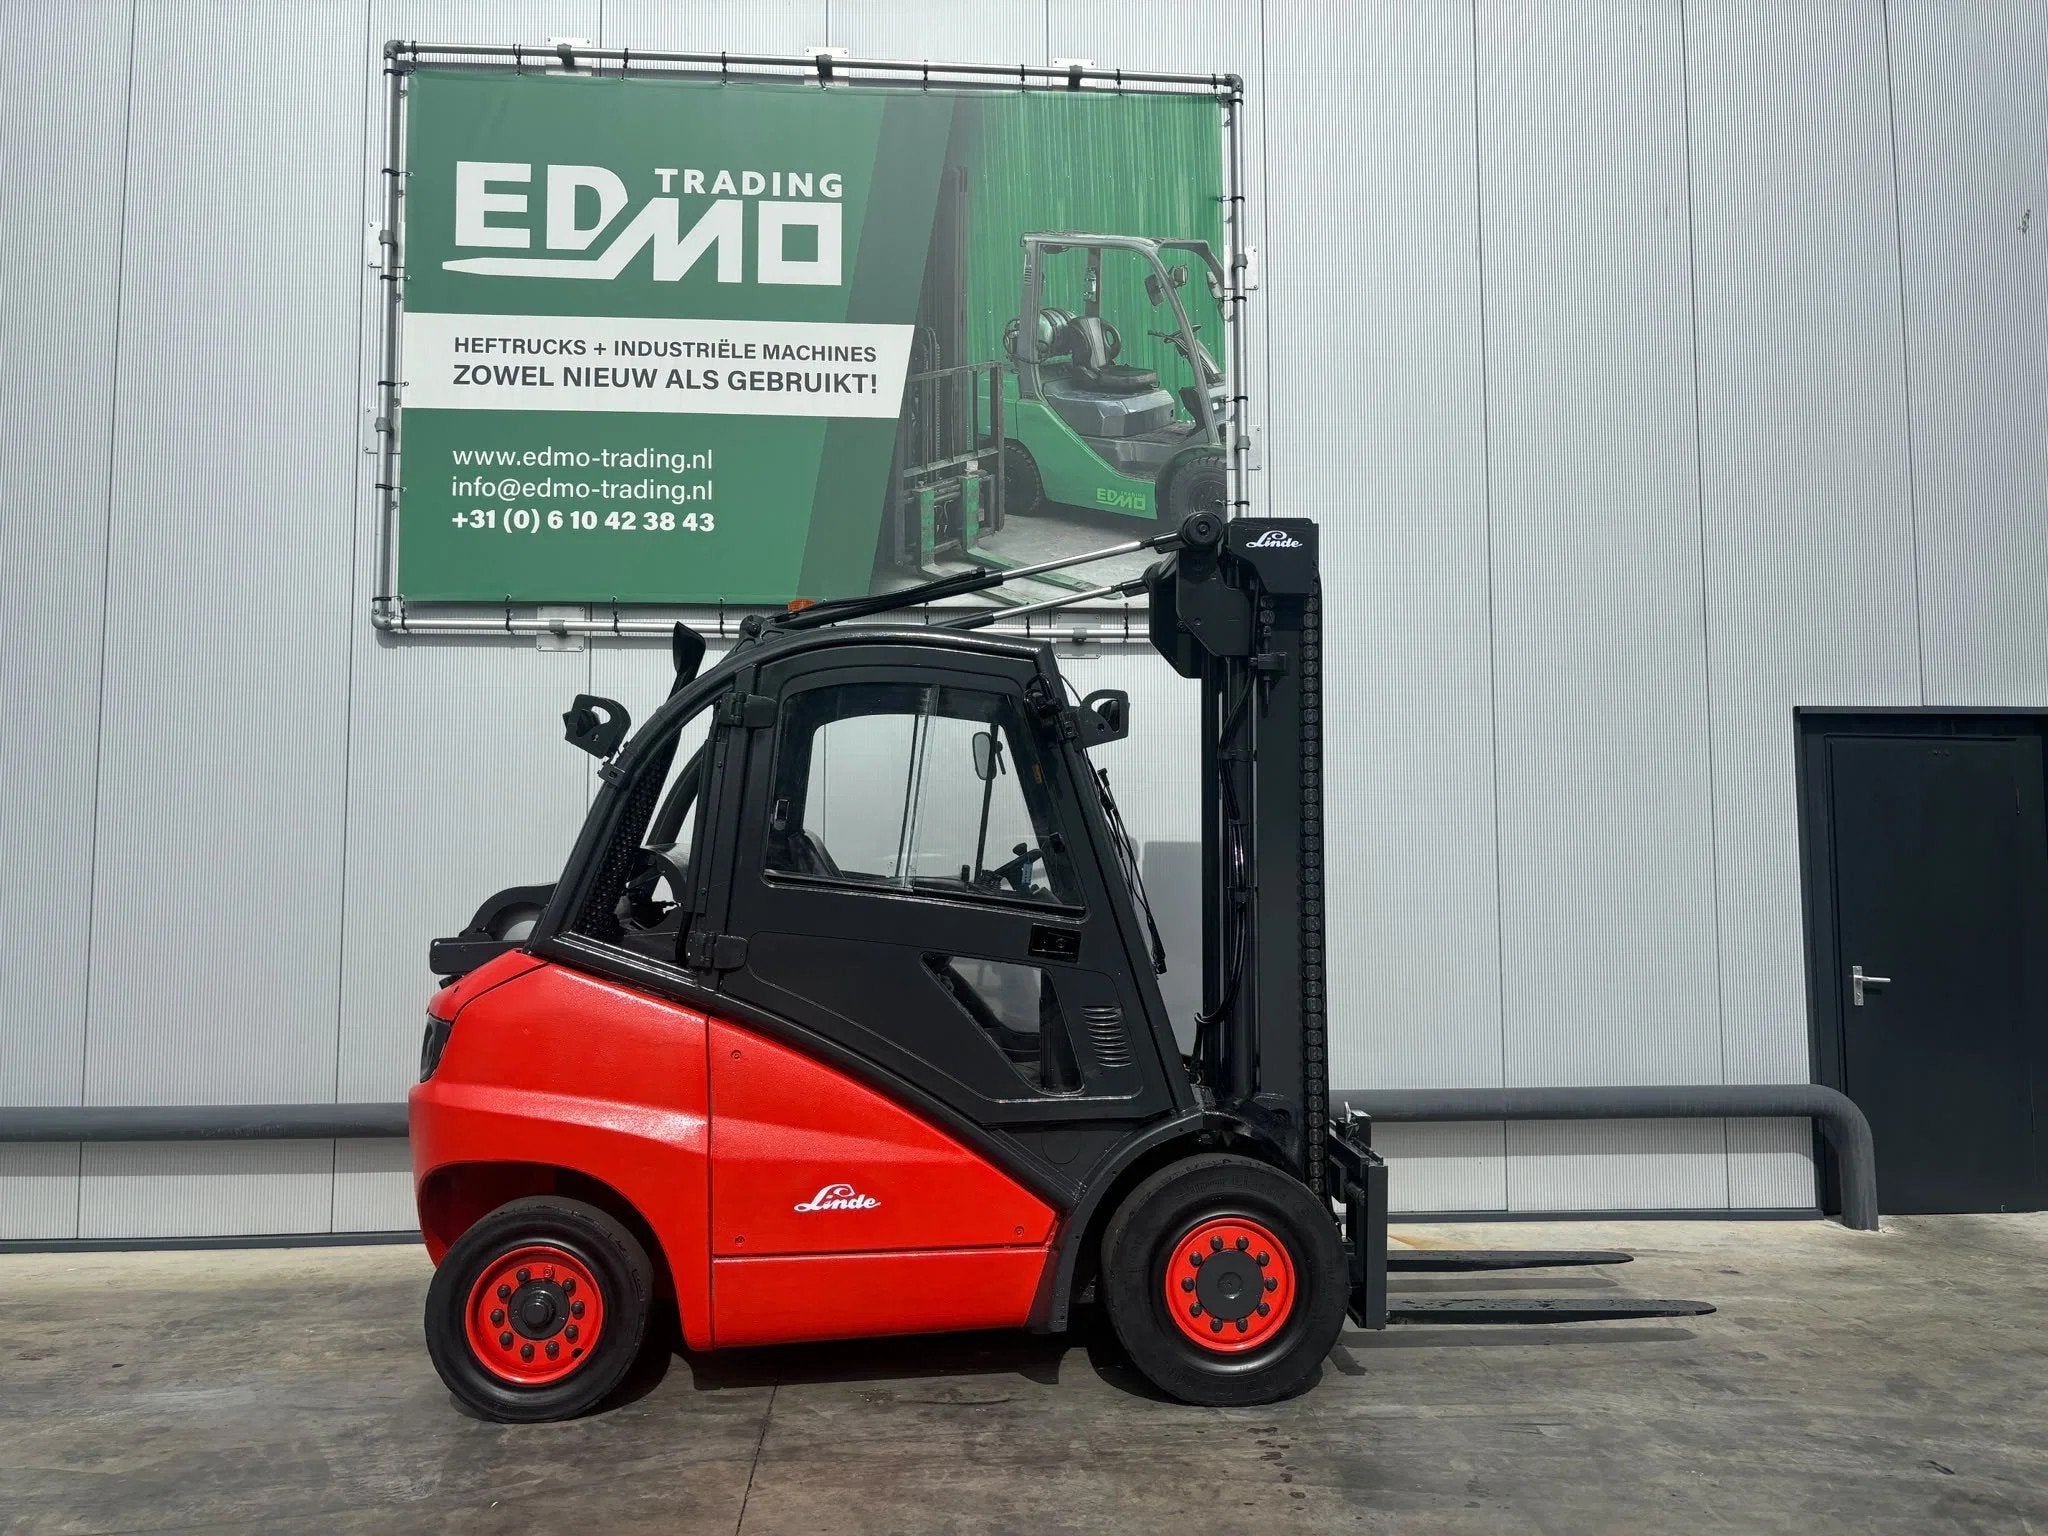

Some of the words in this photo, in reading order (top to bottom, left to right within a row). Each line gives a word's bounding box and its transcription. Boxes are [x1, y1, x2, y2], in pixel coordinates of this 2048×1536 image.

[654, 168, 843, 198] TRADING
[442, 161, 843, 286] EDMO
[454, 337, 587, 356] HEFTRUCKS
[593, 342, 607, 356] +
[614, 339, 757, 360] INDUSTRIËLE
[762, 343, 877, 363] MACHINES
[452, 364, 555, 387] ZOWEL
[563, 366, 658, 389] NIEUW
[665, 368, 719, 390] ALS
[727, 370, 877, 394] GEBRUIKT!
[452, 446, 713, 474] www.edmo-trading.nl
[451, 476, 713, 505] info@edmo-trading.nl
[1096, 487, 1146, 511] EDMO
[451, 509, 496, 529] +31
[503, 508, 540, 533] (0)
[547, 510, 564, 530] 6
[569, 510, 598, 530] 10
[604, 511, 637, 531] 42
[642, 511, 676, 531] 38
[682, 512, 715, 532] 43
[1245, 530, 1303, 548] Linde
[793, 1183, 882, 1212] Linde
